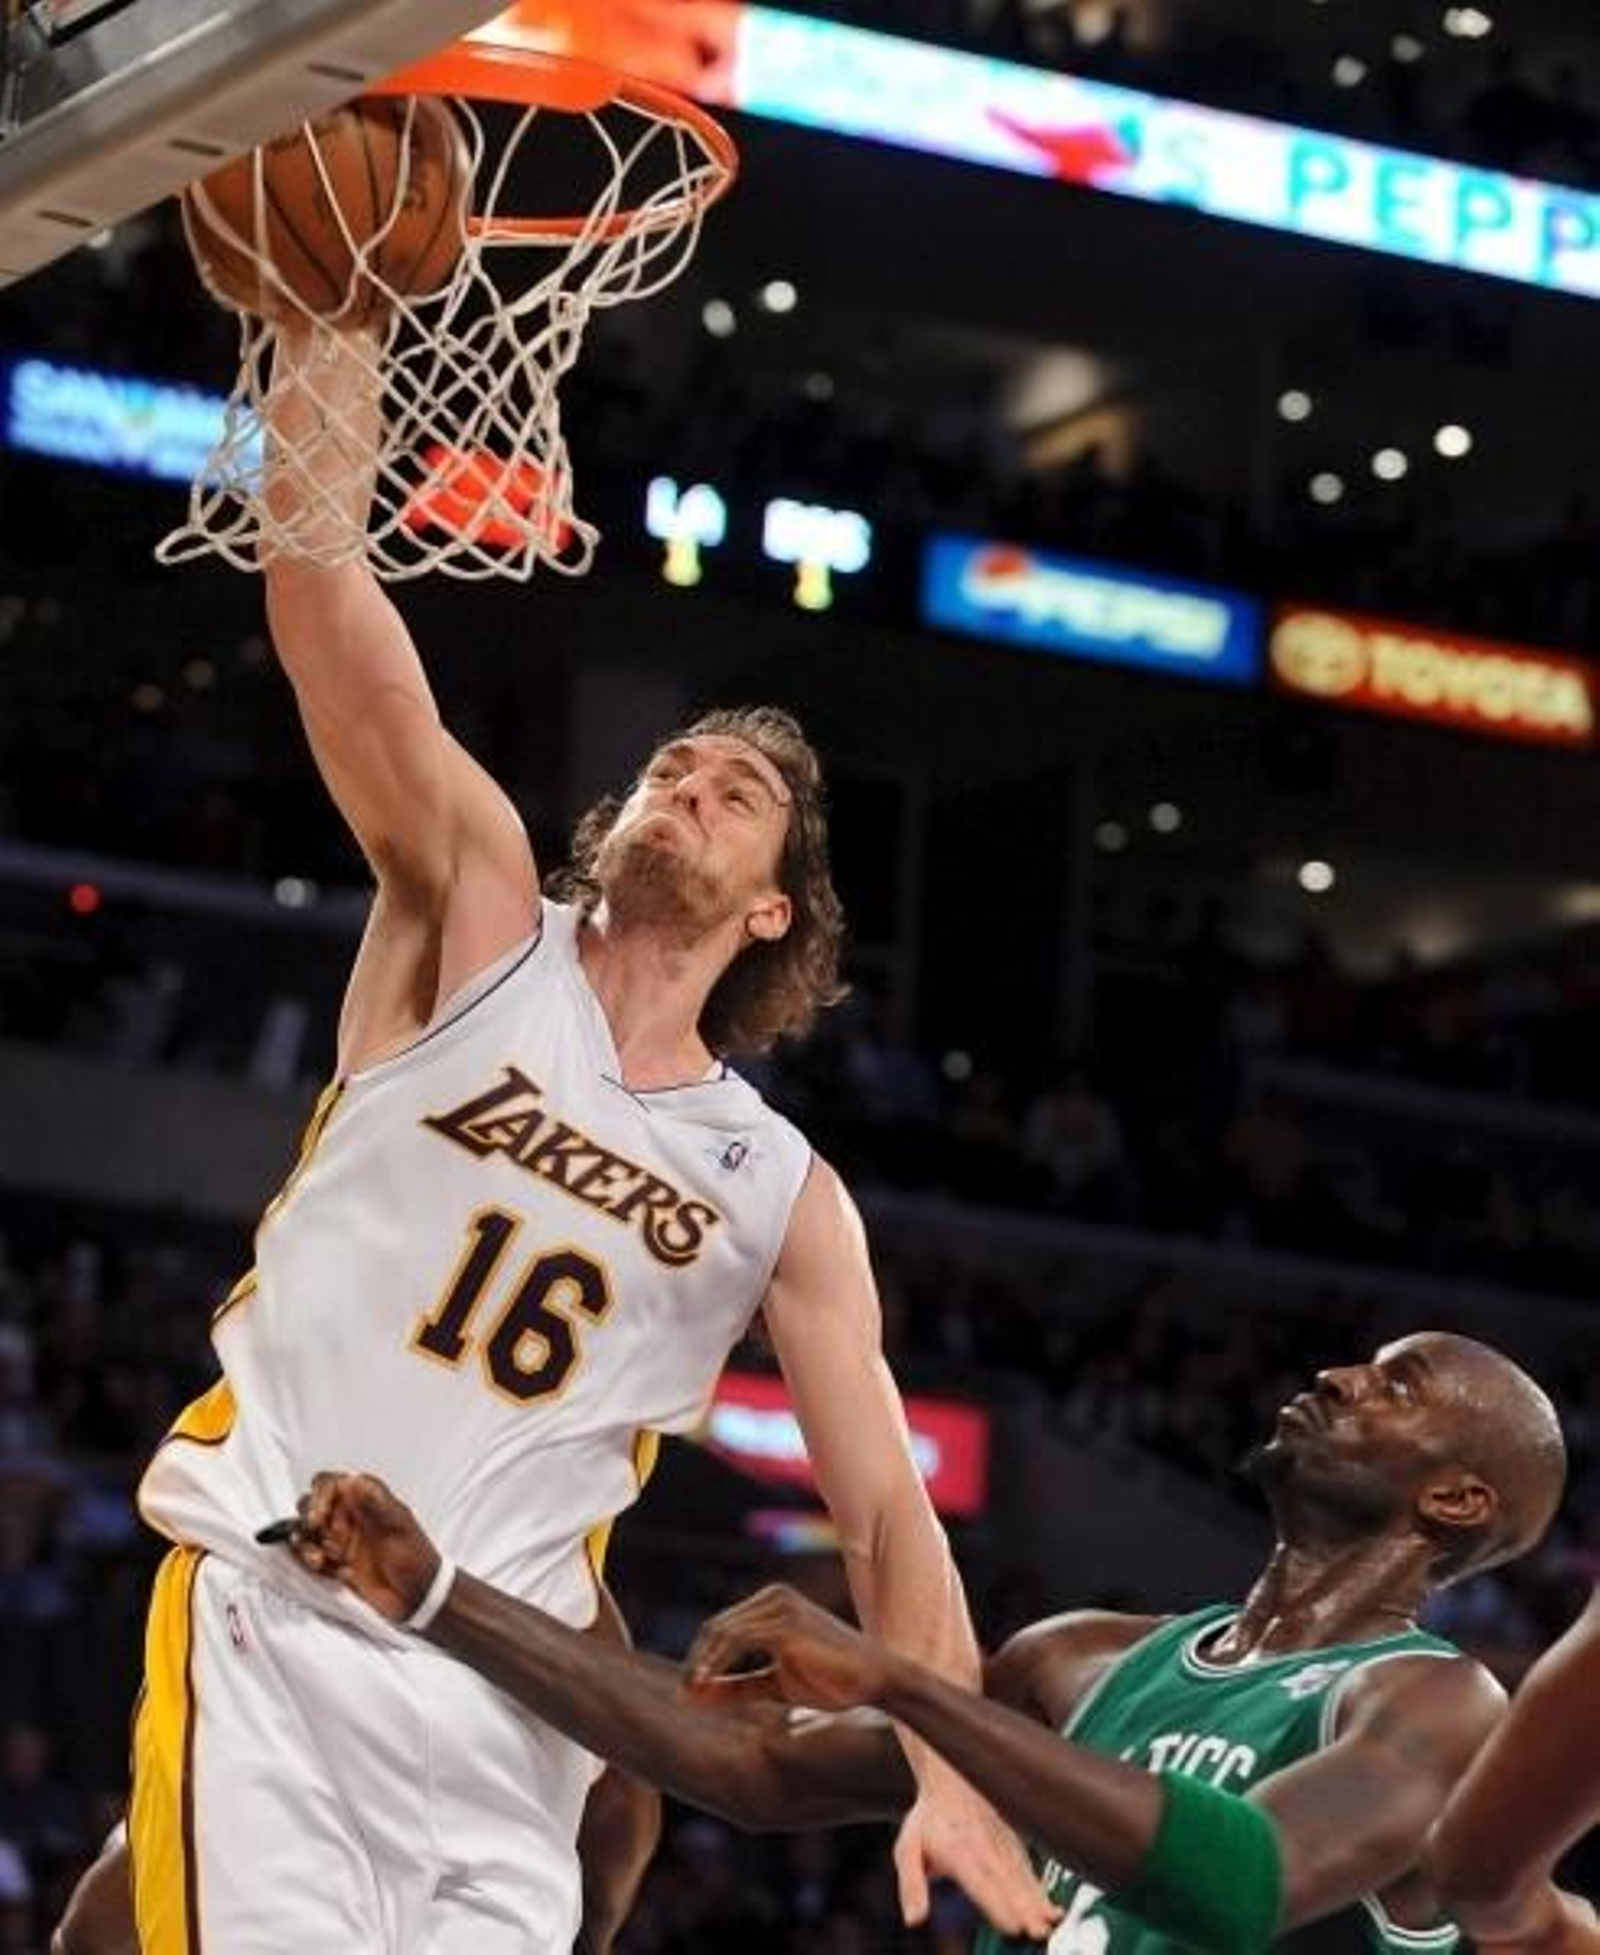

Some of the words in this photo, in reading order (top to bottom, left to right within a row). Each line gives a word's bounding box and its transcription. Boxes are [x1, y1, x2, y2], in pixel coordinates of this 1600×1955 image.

[1368, 632, 1593, 736] TOYOTA
[419, 1065, 721, 1269] LAKERS
[408, 1204, 617, 1407] 16
